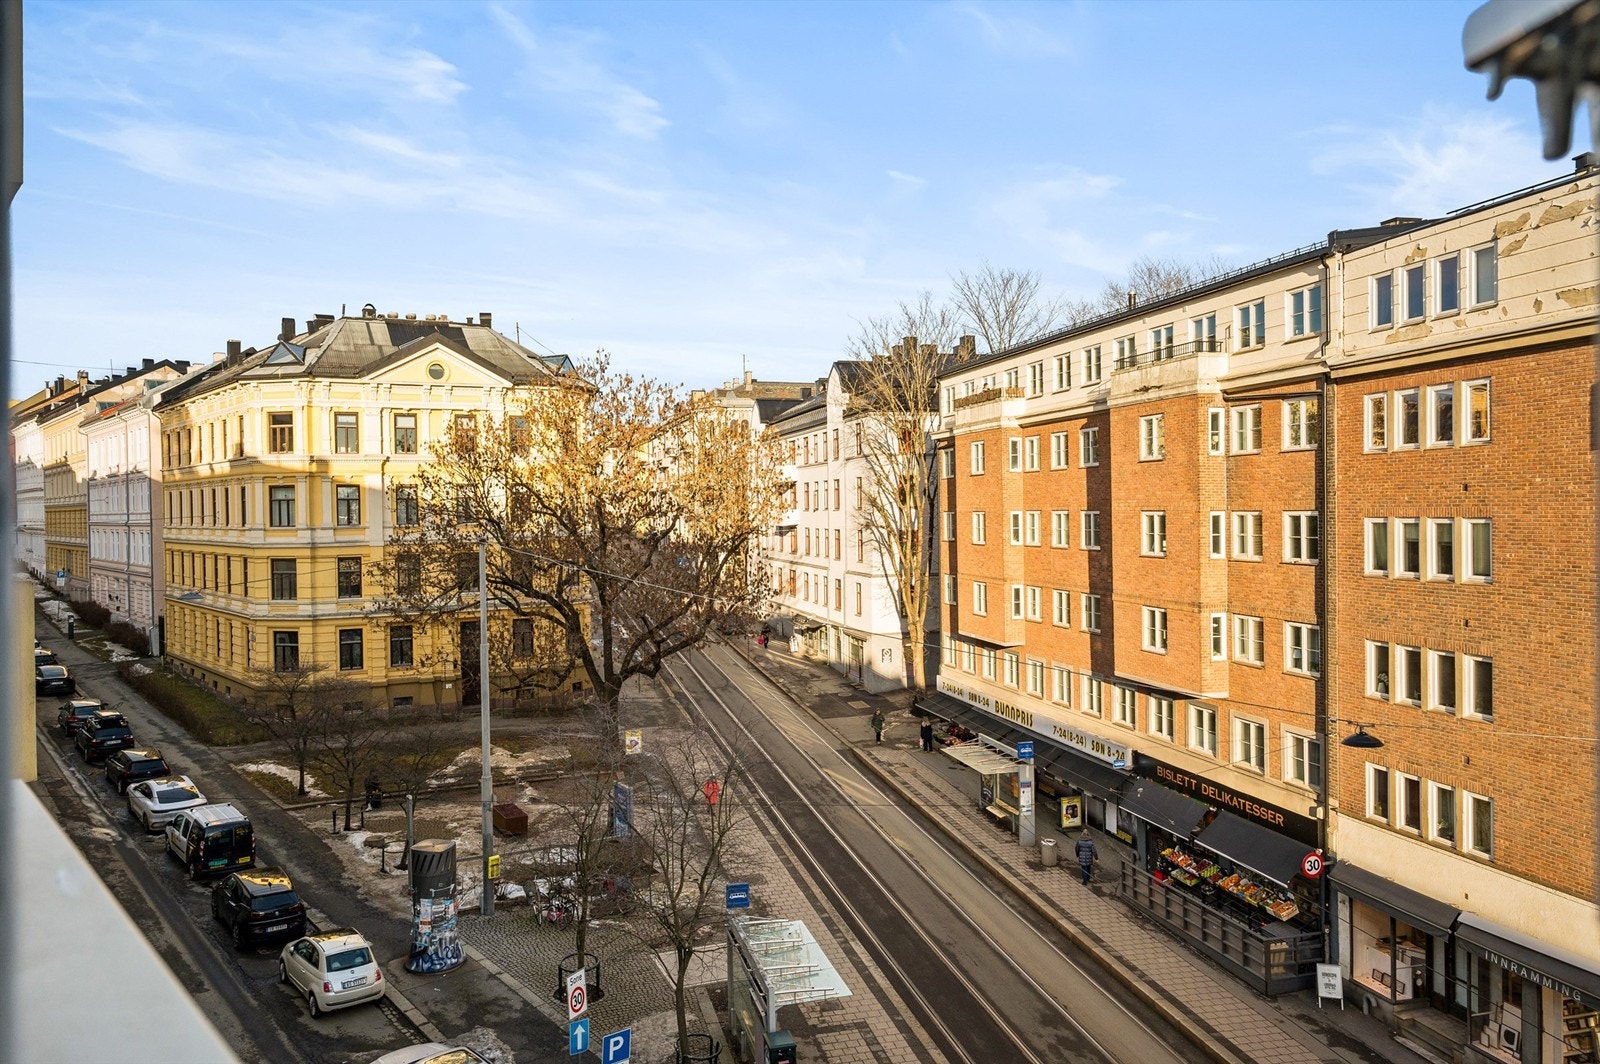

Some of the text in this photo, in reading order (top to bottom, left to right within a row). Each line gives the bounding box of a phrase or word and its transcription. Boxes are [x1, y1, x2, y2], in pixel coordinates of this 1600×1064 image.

[995, 700, 1033, 727] BUNNPRIS
[1053, 725, 1087, 748] 7-24(8-24)
[1091, 740, 1105, 755] SØN
[1107, 746, 1125, 760] 8-24
[1157, 766, 1284, 827] BISLETT DELIKATESSER
[1306, 859, 1320, 872] 30
[570, 974, 583, 986] Sone
[1485, 951, 1582, 1002] INNRAMMING
[573, 992, 582, 1008] 30
[609, 1036, 624, 1061] P
